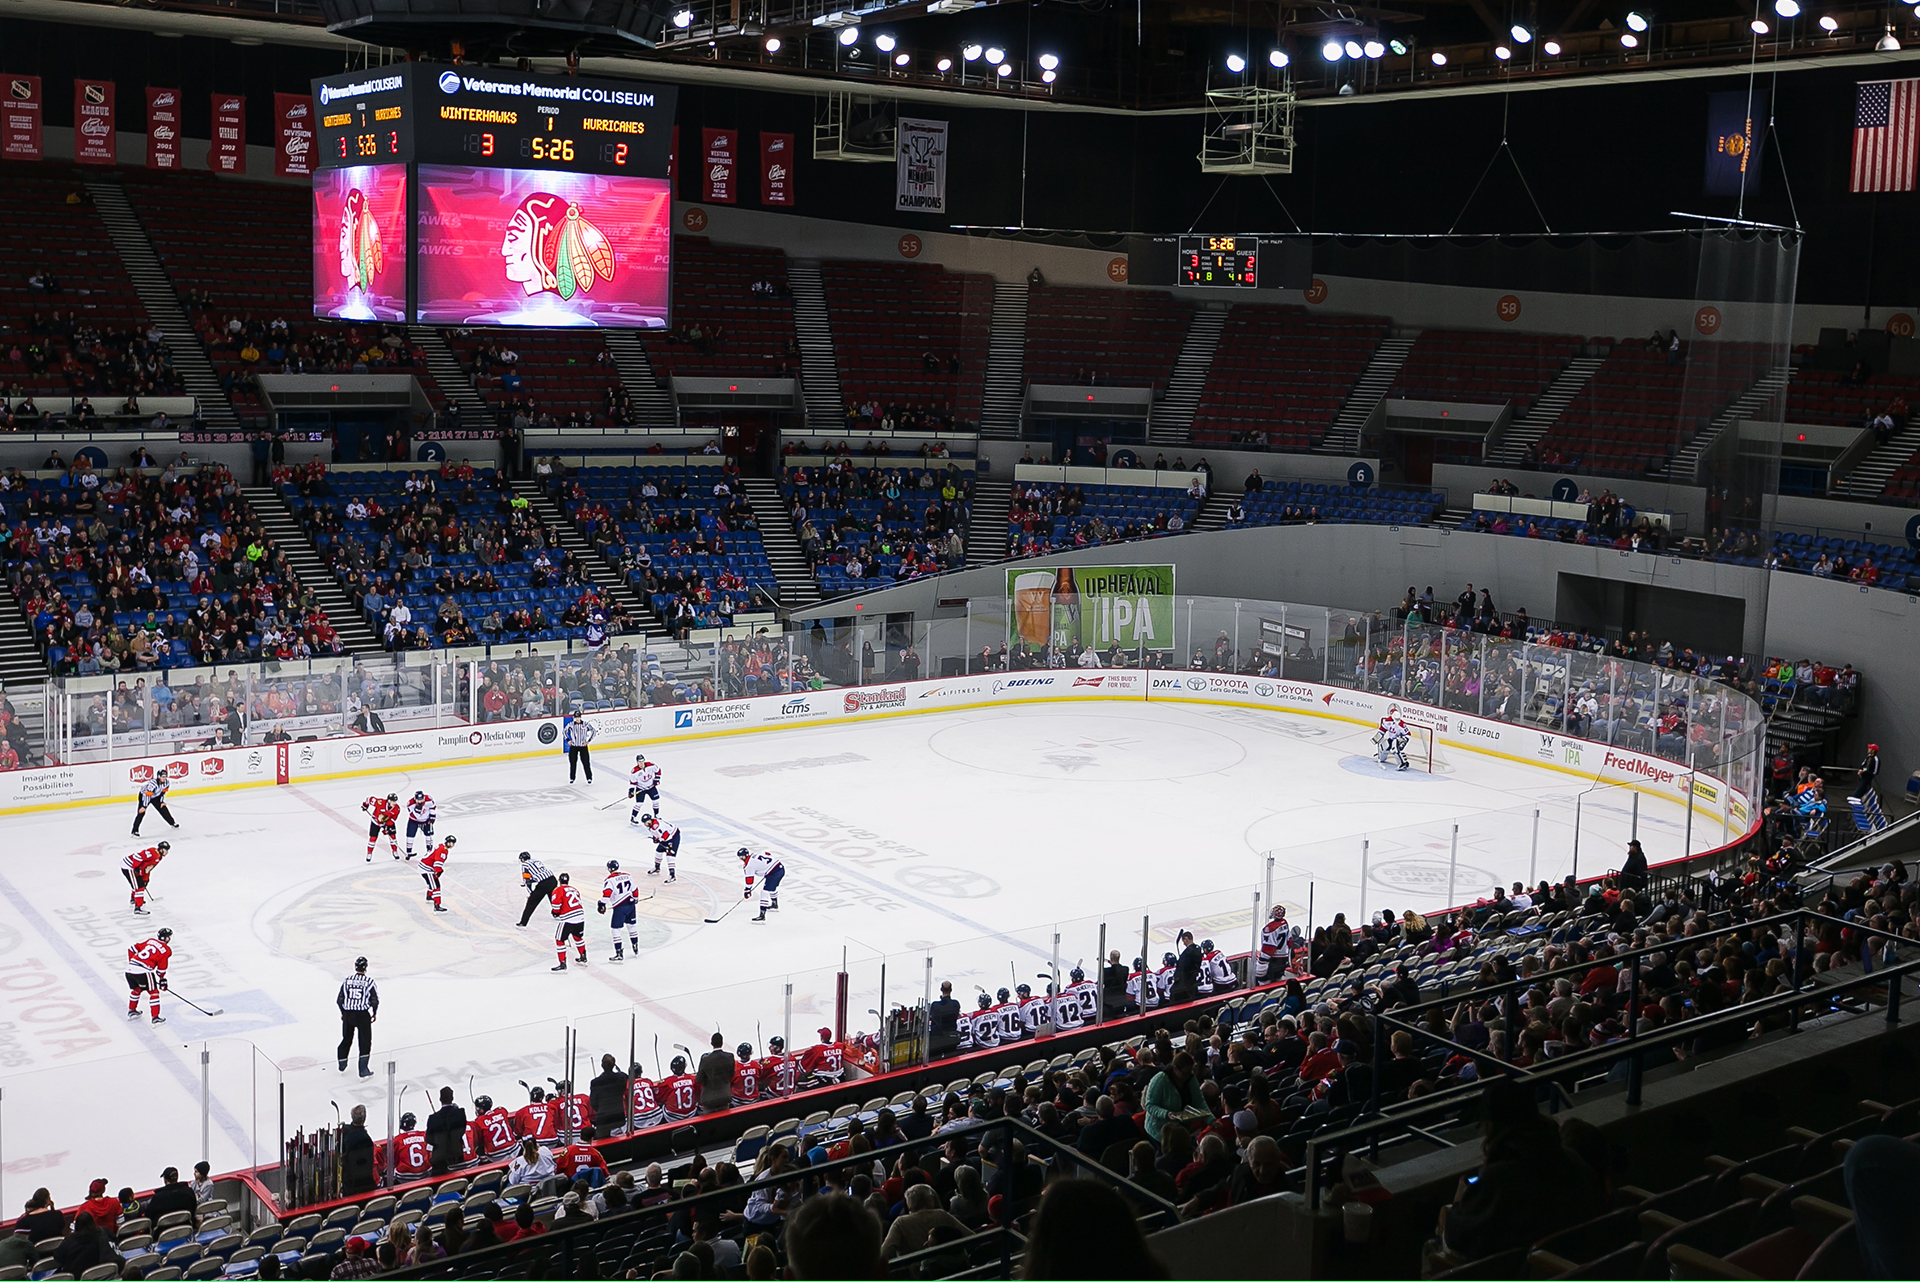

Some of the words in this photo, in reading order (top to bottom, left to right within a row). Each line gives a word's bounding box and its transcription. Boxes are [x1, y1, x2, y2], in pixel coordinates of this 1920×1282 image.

[372, 76, 402, 92] COLISEUM
[463, 77, 522, 95] Veterans
[522, 83, 580, 100] Memorial
[582, 89, 654, 106] COLISEUM
[81, 105, 109, 116] LEAGUE
[440, 106, 517, 124] WINTERHAWKS
[538, 106, 559, 115] PERIOD
[548, 117, 553, 131] 1
[583, 118, 644, 134] HURRICANES
[358, 134, 376, 156] 5:26
[390, 131, 398, 154] 2
[482, 134, 494, 156] 3
[532, 138, 574, 160] 5:26
[615, 144, 628, 165] 2
[900, 195, 941, 208] CHAMPIONS
[687, 215, 702, 224] 54
[902, 241, 917, 250] 55
[1209, 238, 1234, 251] 5:26
[1191, 255, 1198, 267] 3
[1218, 256, 1222, 266] 1
[1247, 256, 1255, 268] 2
[1112, 265, 1126, 274] 56
[1187, 271, 1193, 280] 7
[1206, 272, 1212, 280] 8
[1308, 287, 1323, 296] 57
[1502, 303, 1516, 314] 58
[1701, 315, 1716, 327] 59
[1892, 322, 1910, 334] 60
[180, 433, 194, 442] 35
[230, 433, 244, 442] 20
[309, 432, 322, 440] 25
[428, 431, 440, 439] 21
[441, 431, 453, 439] 14
[455, 431, 466, 439] 27
[428, 449, 436, 461] 2
[1356, 470, 1365, 482] 6
[1562, 487, 1569, 499] 7
[1085, 574, 1163, 598] UPHEAVAL
[1102, 598, 1154, 642] IPA
[1007, 678, 1055, 687] BOEING
[1209, 678, 1248, 688] TOYOTA
[1276, 685, 1313, 697] TOYOTA
[844, 687, 906, 713] Standard
[876, 701, 905, 710] APPLIANCE
[1356, 702, 1373, 710] BANK
[696, 706, 722, 714] PACIFIC
[781, 704, 810, 715] tcms
[1403, 706, 1425, 716] ORDER
[1426, 712, 1448, 722] ONLINE
[605, 716, 642, 726] compass
[696, 712, 745, 722] AUTOMATION
[605, 724, 642, 735] oncology
[1468, 726, 1500, 739] LEUPOLD
[438, 734, 468, 746] Pamplin
[483, 731, 504, 741] Media
[505, 730, 525, 739] Group
[366, 745, 387, 753] 503
[1561, 740, 1584, 751] UPHEAVAL
[1565, 748, 1580, 766] IPA
[202, 759, 223, 774] Jack
[22, 774, 57, 782] Imagine
[132, 766, 153, 781] Jack
[23, 782, 74, 792] Possibilities
[13, 790, 84, 800] OregonCollegeSavings.com
[790, 805, 846, 830] Places
[847, 828, 879, 840] Go
[875, 838, 928, 858] Let's
[748, 810, 896, 869] TOYOTA
[810, 875, 906, 913] OFFICE
[53, 904, 122, 948] OFFICE
[1202, 917, 1227, 928] LES
[1080, 990, 1097, 1010] 21
[0, 957, 112, 1060] TOYOTA
[1060, 1003, 1079, 1023] 12
[1030, 1006, 1048, 1026] 18
[1003, 1013, 1020, 1033] 16
[826, 1056, 841, 1072] 31
[744, 1076, 755, 1096] 8
[776, 1069, 795, 1090] 20
[634, 1087, 655, 1110] 39
[675, 1087, 692, 1109] 13
[533, 1113, 547, 1135] 7
[490, 1120, 512, 1147] 21
[409, 1144, 424, 1167] 6
